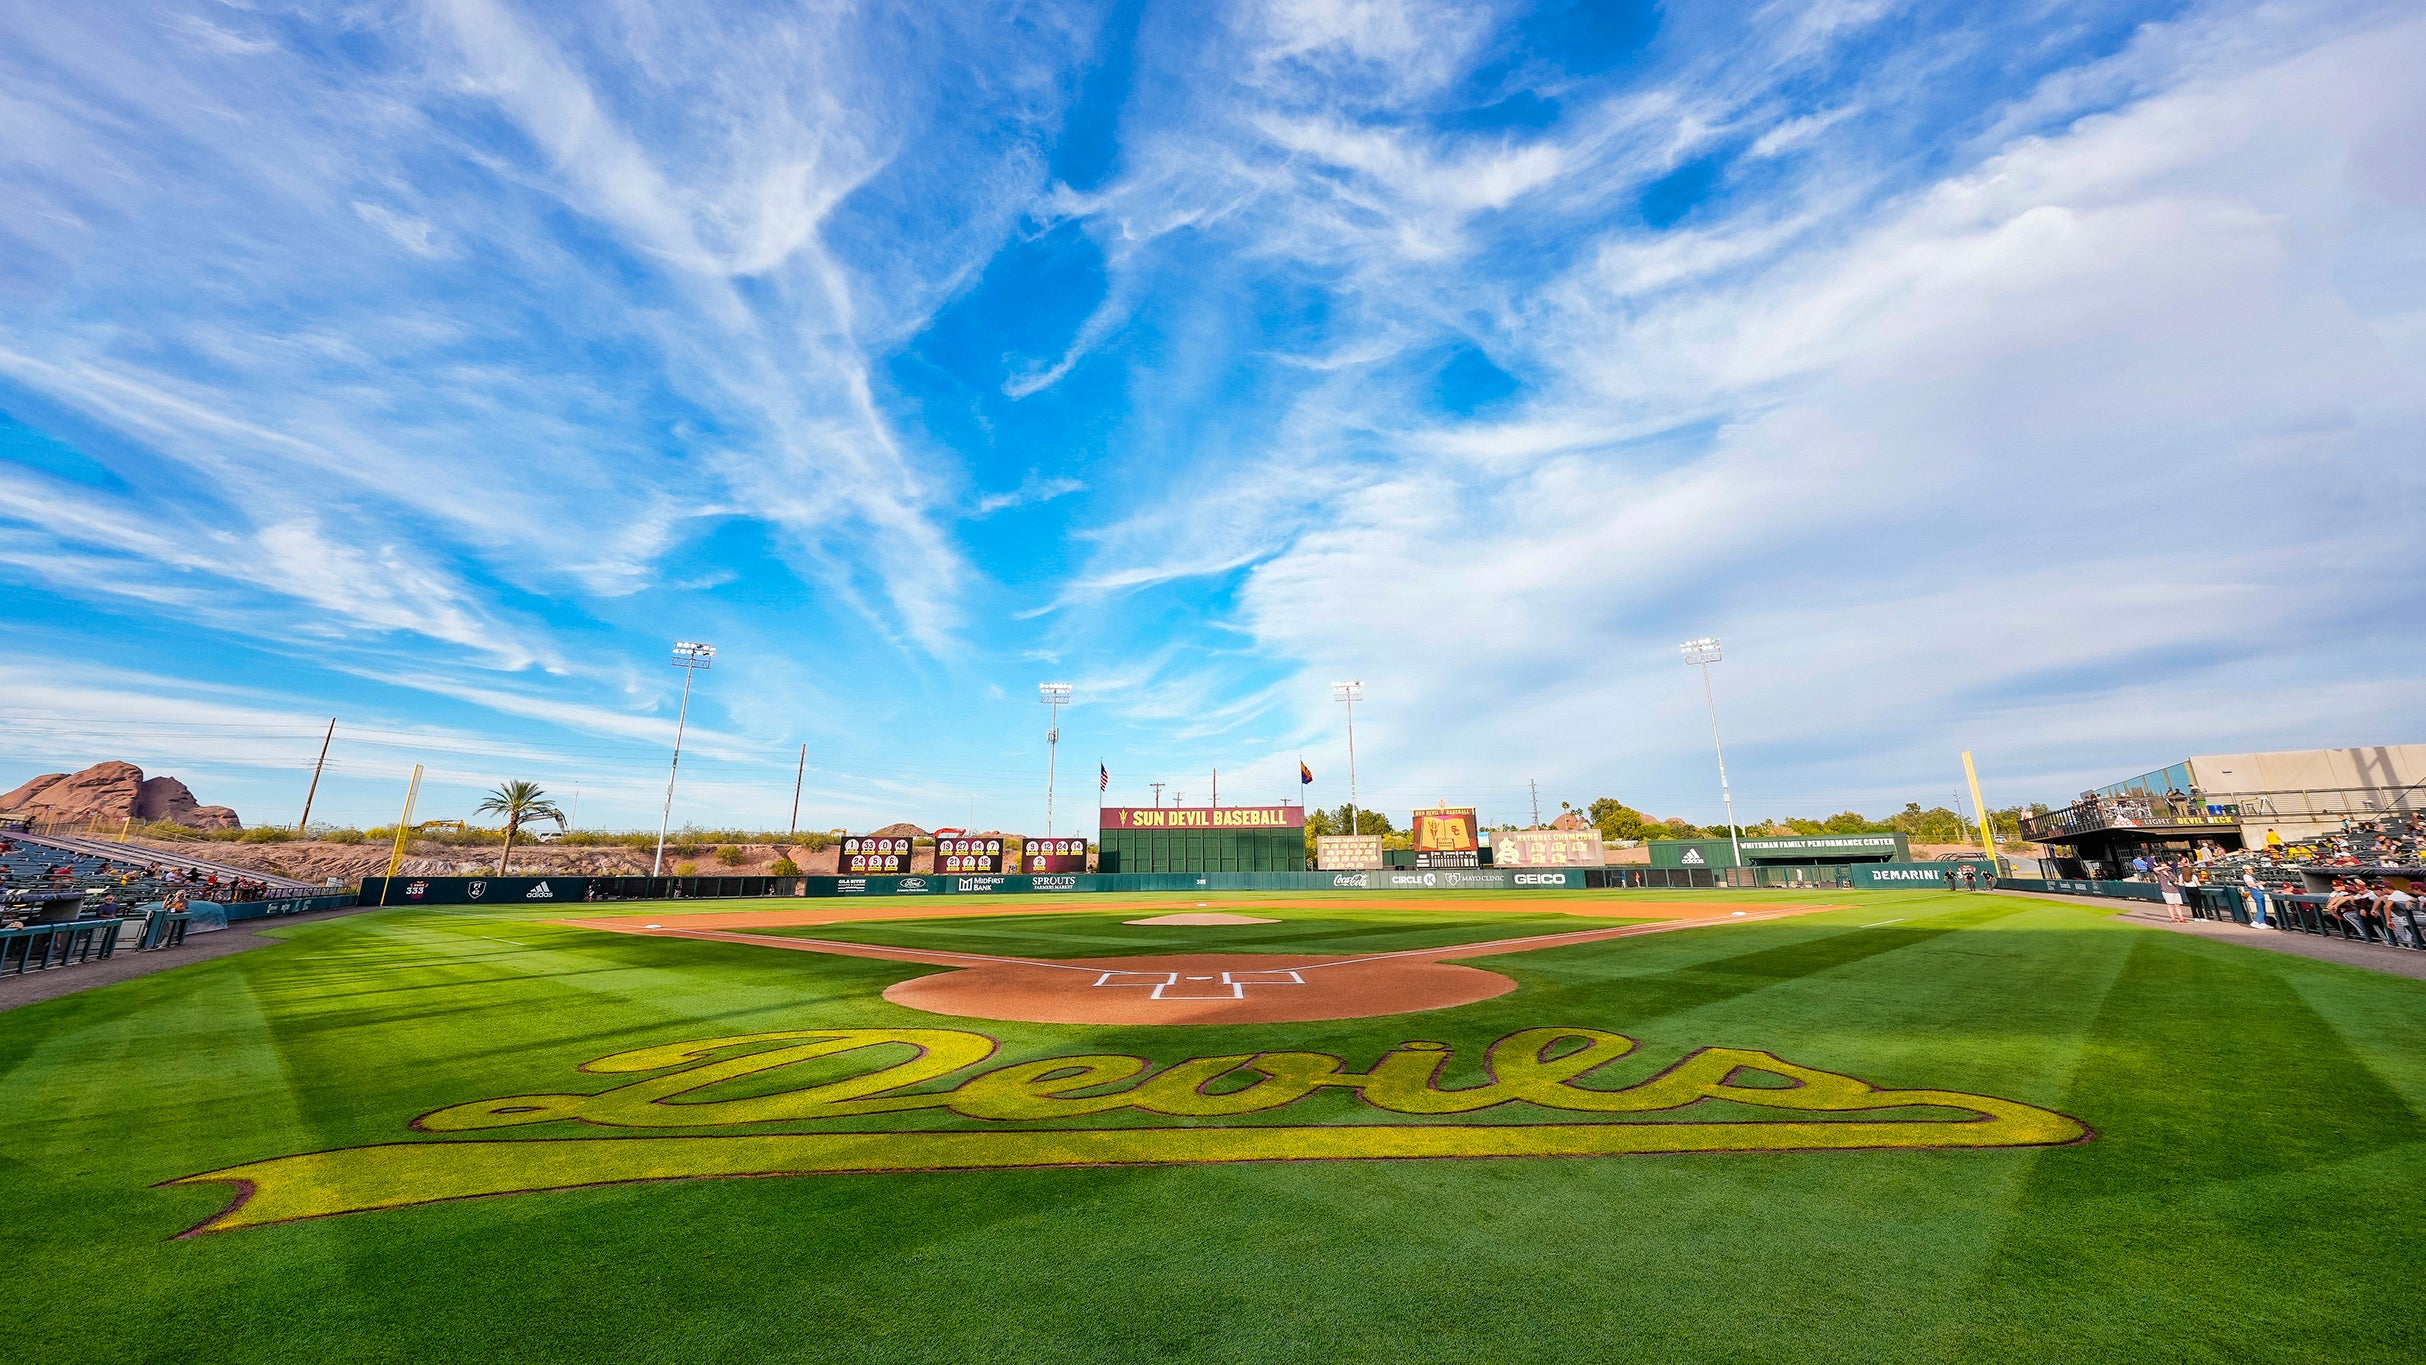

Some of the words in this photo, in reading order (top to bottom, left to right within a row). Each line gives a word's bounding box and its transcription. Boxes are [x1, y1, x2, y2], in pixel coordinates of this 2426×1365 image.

[1132, 810, 1164, 826] SUN
[1168, 810, 1210, 826] DEVIL
[1213, 810, 1287, 826] BASEBALL
[1807, 839, 1863, 847] PERFORMANCE
[1514, 874, 1566, 884] GEICO
[1872, 870, 1939, 880] DEMARINI
[1032, 876, 1076, 885] SPROUTS
[1334, 874, 1369, 886] Coca-Cola
[1392, 876, 1422, 884] CIRCLE
[406, 886, 425, 894] 333
